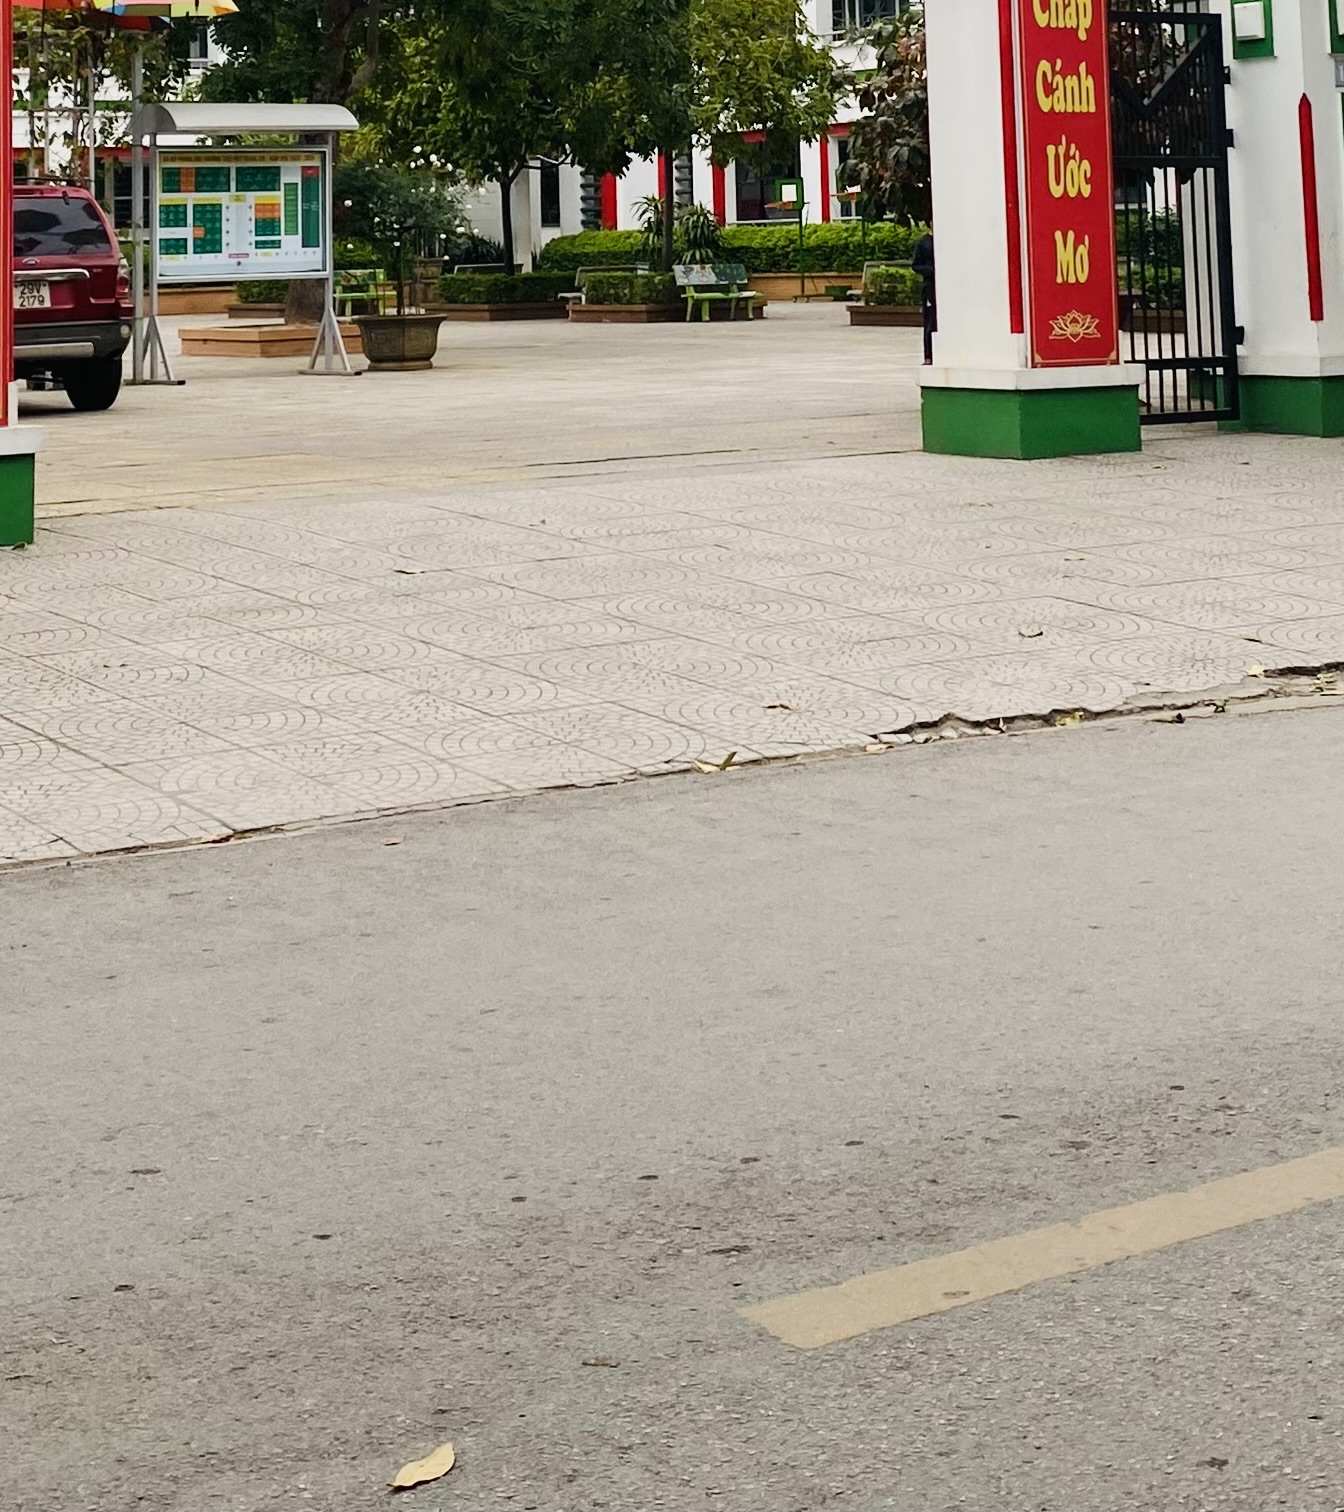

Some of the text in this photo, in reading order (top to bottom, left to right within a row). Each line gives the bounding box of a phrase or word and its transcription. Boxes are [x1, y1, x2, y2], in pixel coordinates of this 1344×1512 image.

[1036, 58, 1096, 113] Cánh
[1046, 134, 1091, 198] Ước
[1054, 230, 1090, 283] Mơ
